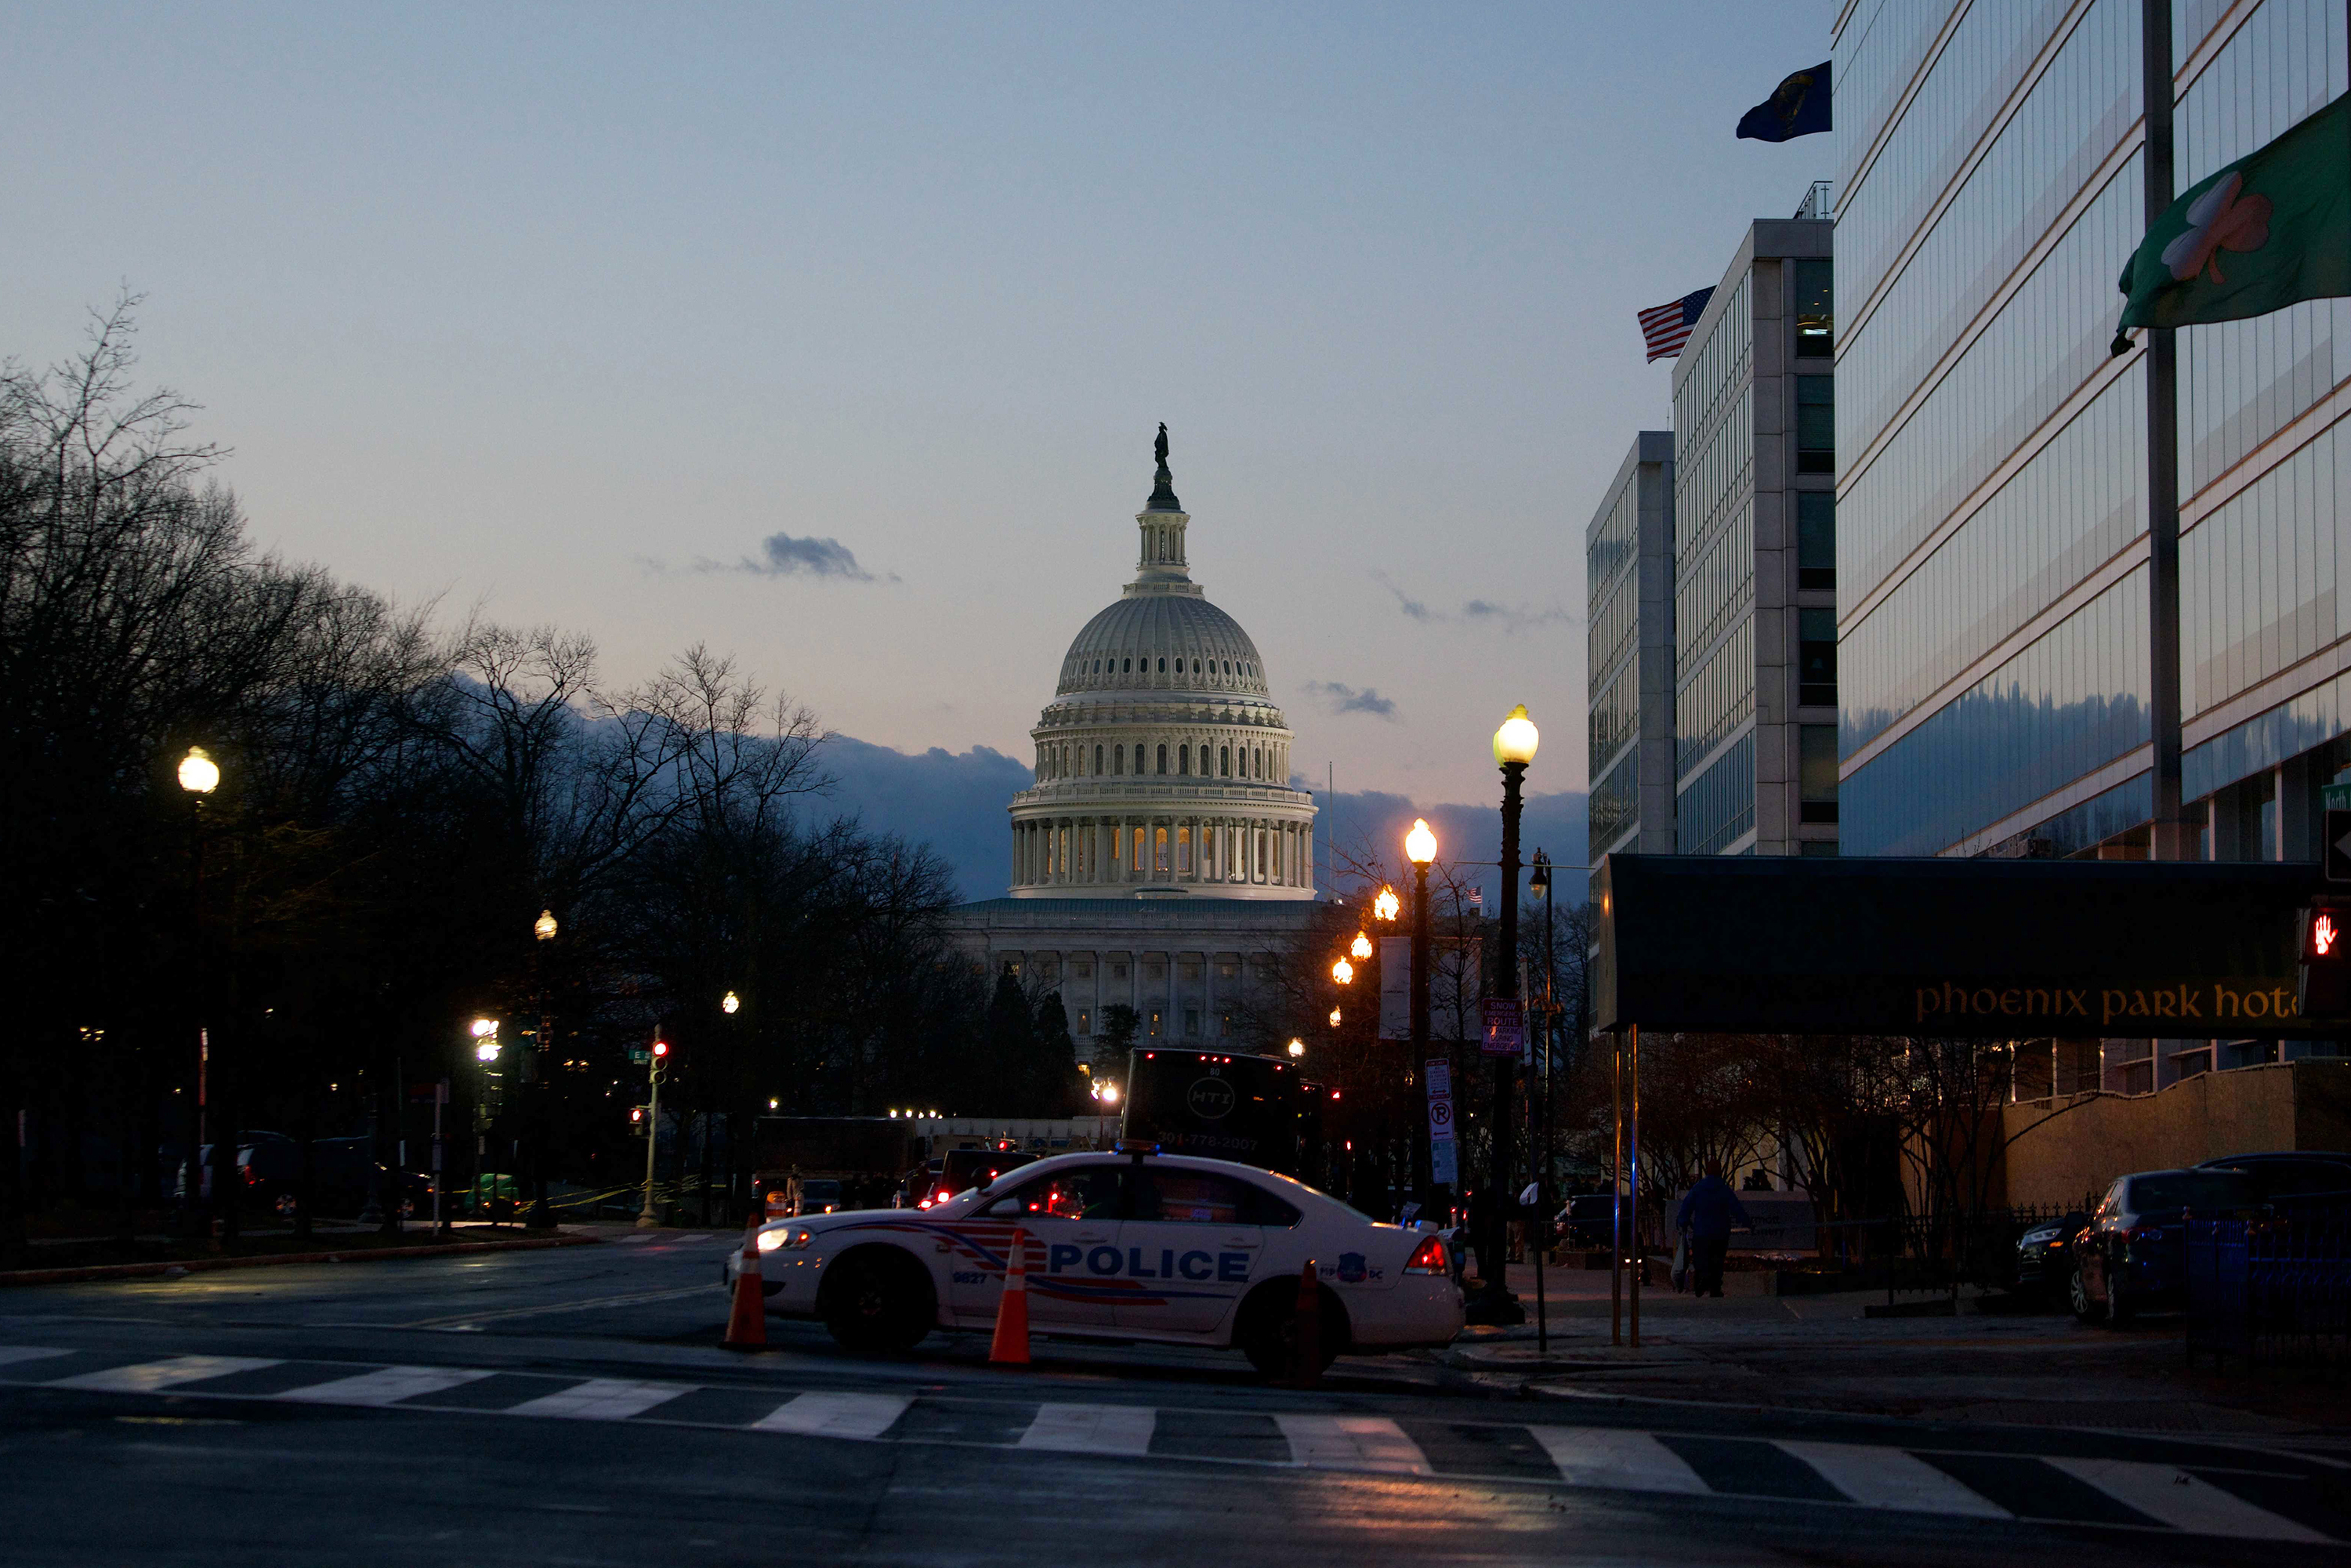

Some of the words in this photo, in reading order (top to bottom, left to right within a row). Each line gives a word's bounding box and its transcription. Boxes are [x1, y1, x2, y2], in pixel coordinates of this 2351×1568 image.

[2325, 790, 2347, 810] North
[1490, 1001, 1516, 1011] SNOW
[1915, 980, 2090, 1023] phoenix
[2102, 984, 2203, 1026] park
[1487, 1017, 1519, 1026] ROUTE
[1210, 1067, 1220, 1076] 80
[1192, 1091, 1231, 1104] HTI
[1050, 1244, 1250, 1282] POLICE
[1369, 1269, 1383, 1280] DC
